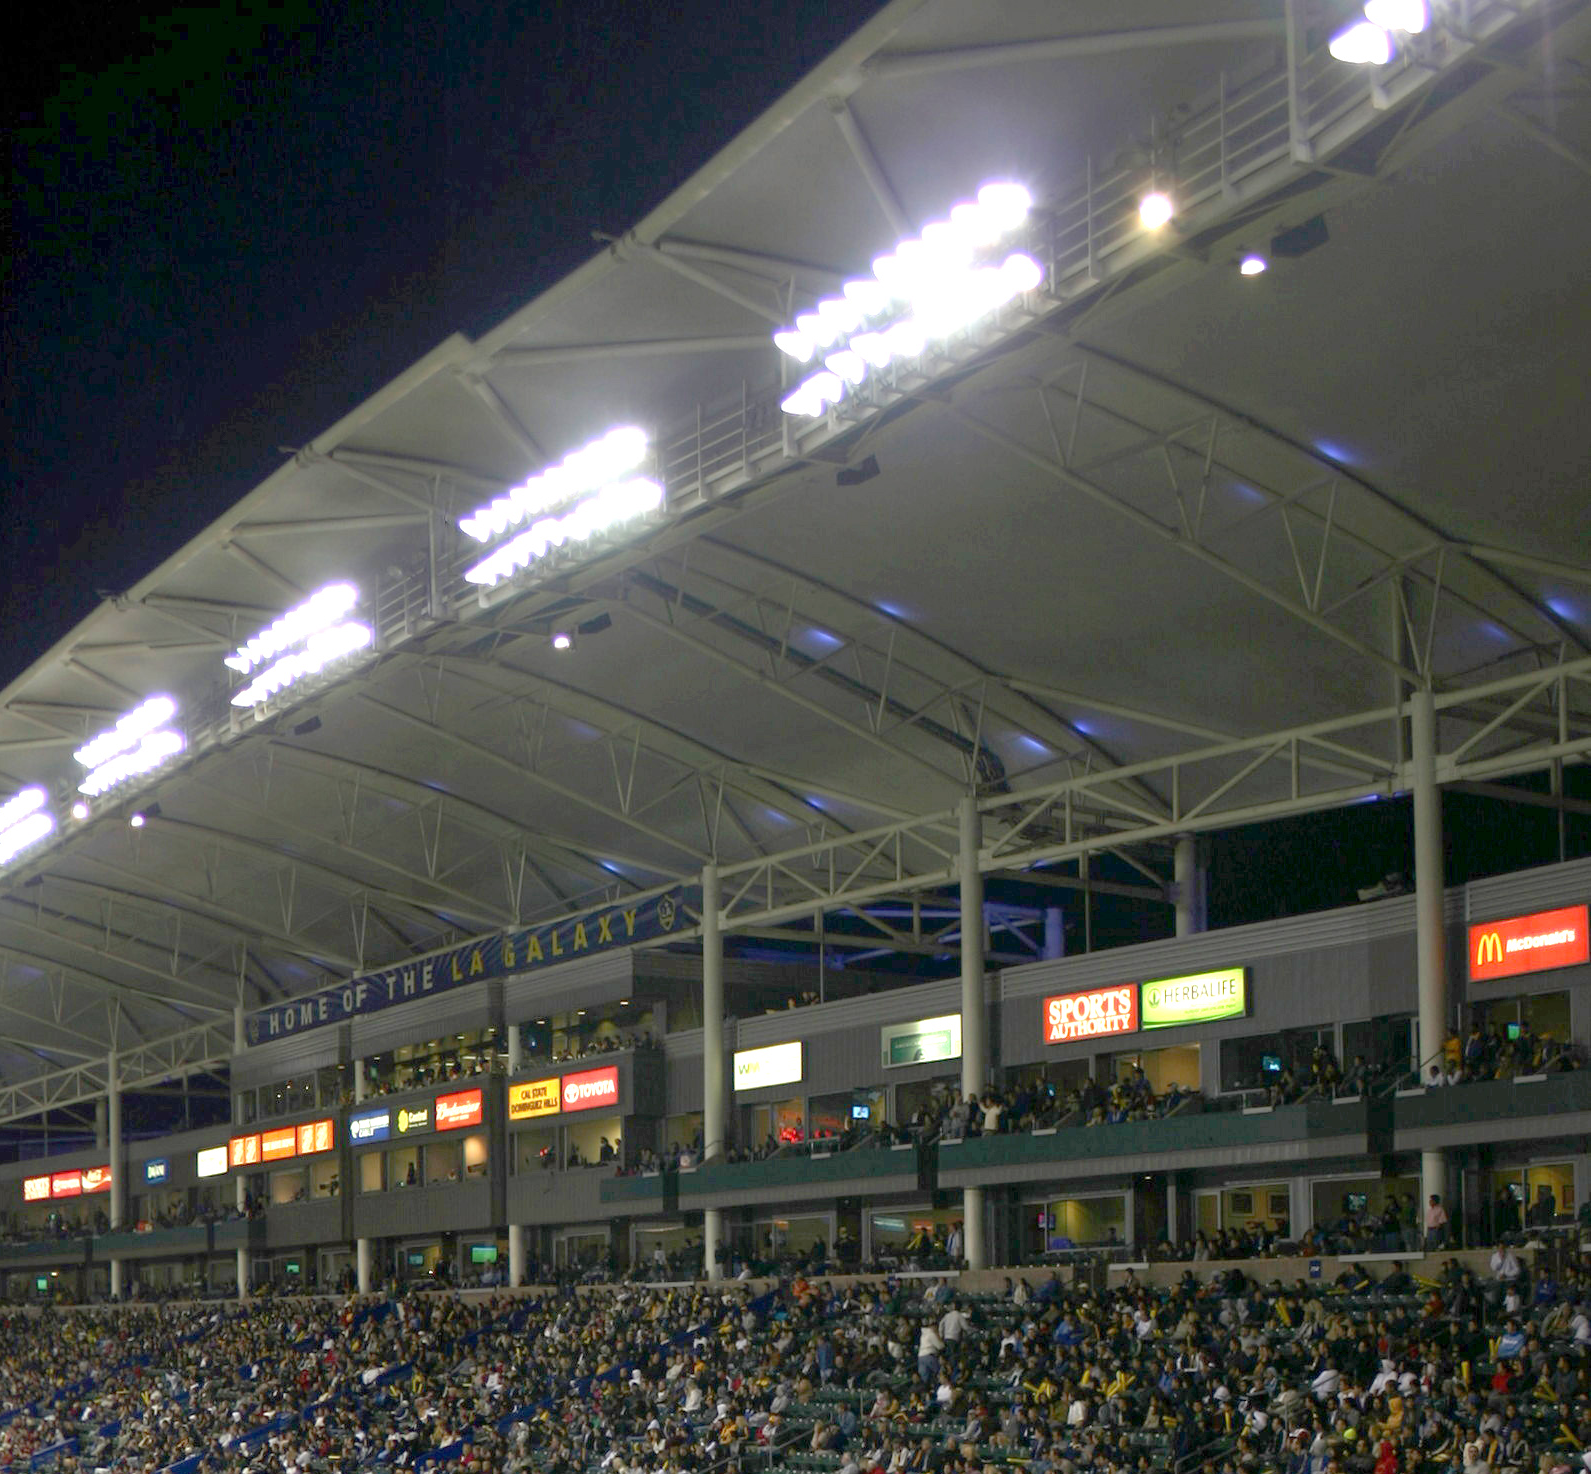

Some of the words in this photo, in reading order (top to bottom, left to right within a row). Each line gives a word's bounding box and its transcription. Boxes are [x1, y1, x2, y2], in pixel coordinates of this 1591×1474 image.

[1506, 928, 1576, 953] McDonald's
[269, 998, 328, 1035] HOME
[342, 984, 369, 1013] OF
[386, 966, 434, 1001] THE
[451, 949, 484, 981] LA
[504, 909, 638, 969] GALAXY
[1164, 978, 1237, 1004] HERBALIFE
[1048, 988, 1132, 1025] SPORTS
[1049, 1013, 1131, 1041] AUTHORITY
[578, 1080, 615, 1099] TOYOTA
